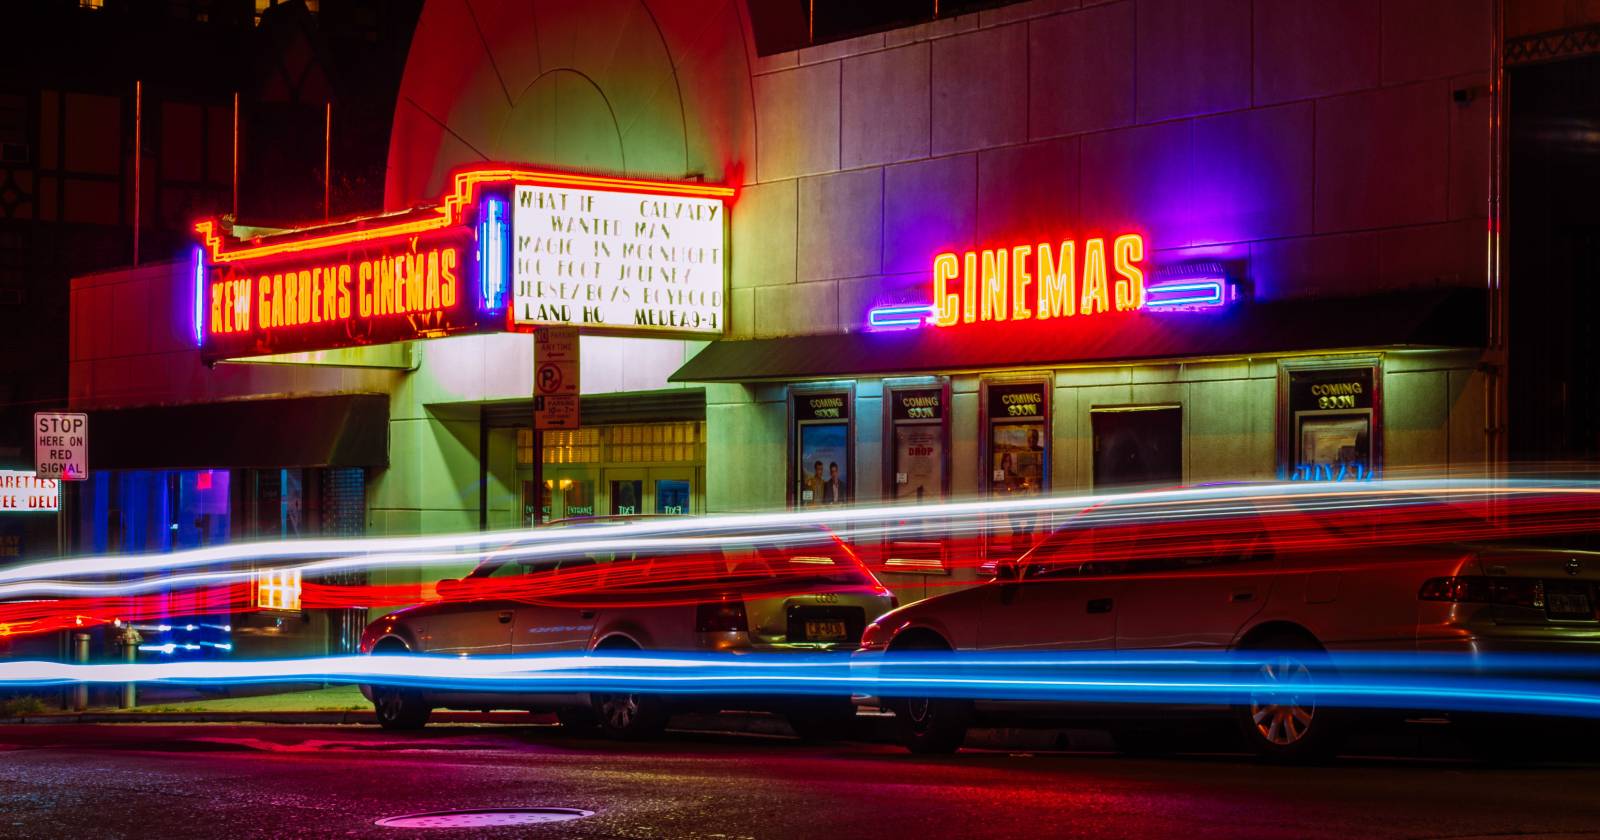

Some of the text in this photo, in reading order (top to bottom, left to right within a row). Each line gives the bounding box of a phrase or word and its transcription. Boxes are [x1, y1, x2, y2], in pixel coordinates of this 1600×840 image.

[519, 191, 718, 222] WHAT IF CALVARY
[551, 216, 671, 240] WANTED MAN
[518, 235, 719, 264] MAGIC IN MOONLIGHT
[518, 258, 691, 285] 100 FOOT JOURNEY
[933, 234, 1145, 327] CINEMAS
[211, 248, 456, 334] KEW GARDENS CINEMAS
[644, 287, 721, 307] BOYHOOD
[525, 303, 572, 322] LAND
[583, 305, 604, 323] HO
[1312, 383, 1362, 395] COMING
[810, 398, 843, 408] COMING
[902, 396, 939, 407] COMING
[1002, 393, 1041, 404] COMING
[1319, 395, 1355, 409] SOON
[815, 408, 840, 418] SOON
[908, 407, 934, 418] SOON
[1008, 404, 1037, 416] SOON
[40, 418, 83, 433] STOP
[40, 436, 83, 446] HERE ON
[50, 450, 72, 460] RED
[908, 447, 934, 456] DROP
[41, 463, 82, 473] SIGNAL
[29, 495, 57, 508] DELI
